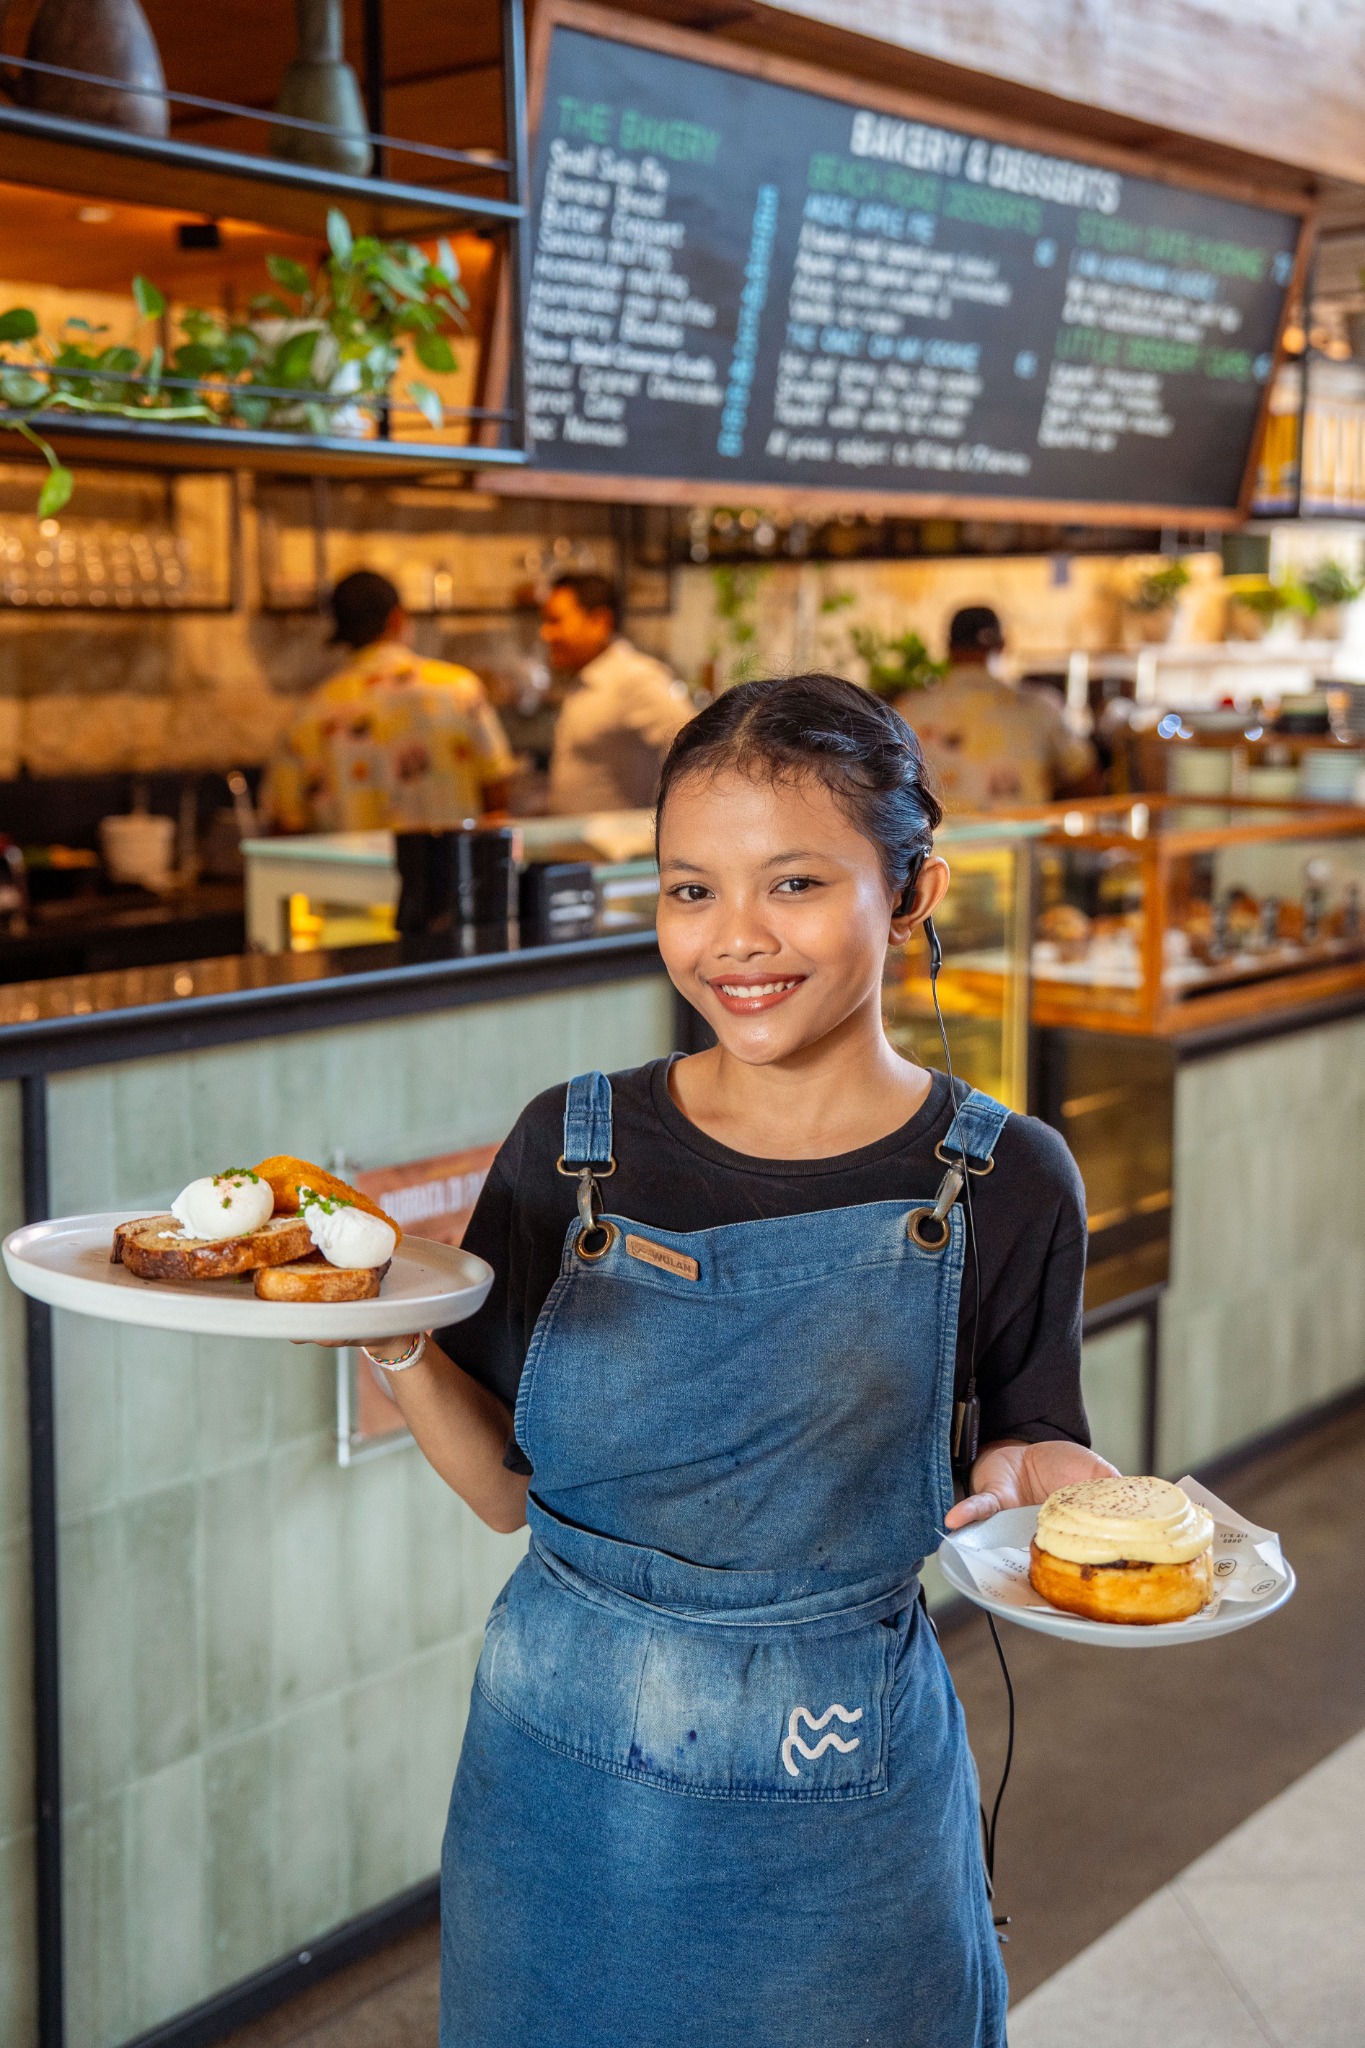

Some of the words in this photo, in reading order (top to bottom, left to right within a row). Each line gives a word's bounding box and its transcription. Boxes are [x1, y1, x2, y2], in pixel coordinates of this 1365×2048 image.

[558, 97, 612, 143] THE
[620, 109, 722, 165] BAKERY
[851, 112, 965, 175] BAKERY
[965, 141, 988, 182] &
[988, 145, 1123, 213] DESSERTS
[651, 1250, 692, 1274] WULAN
